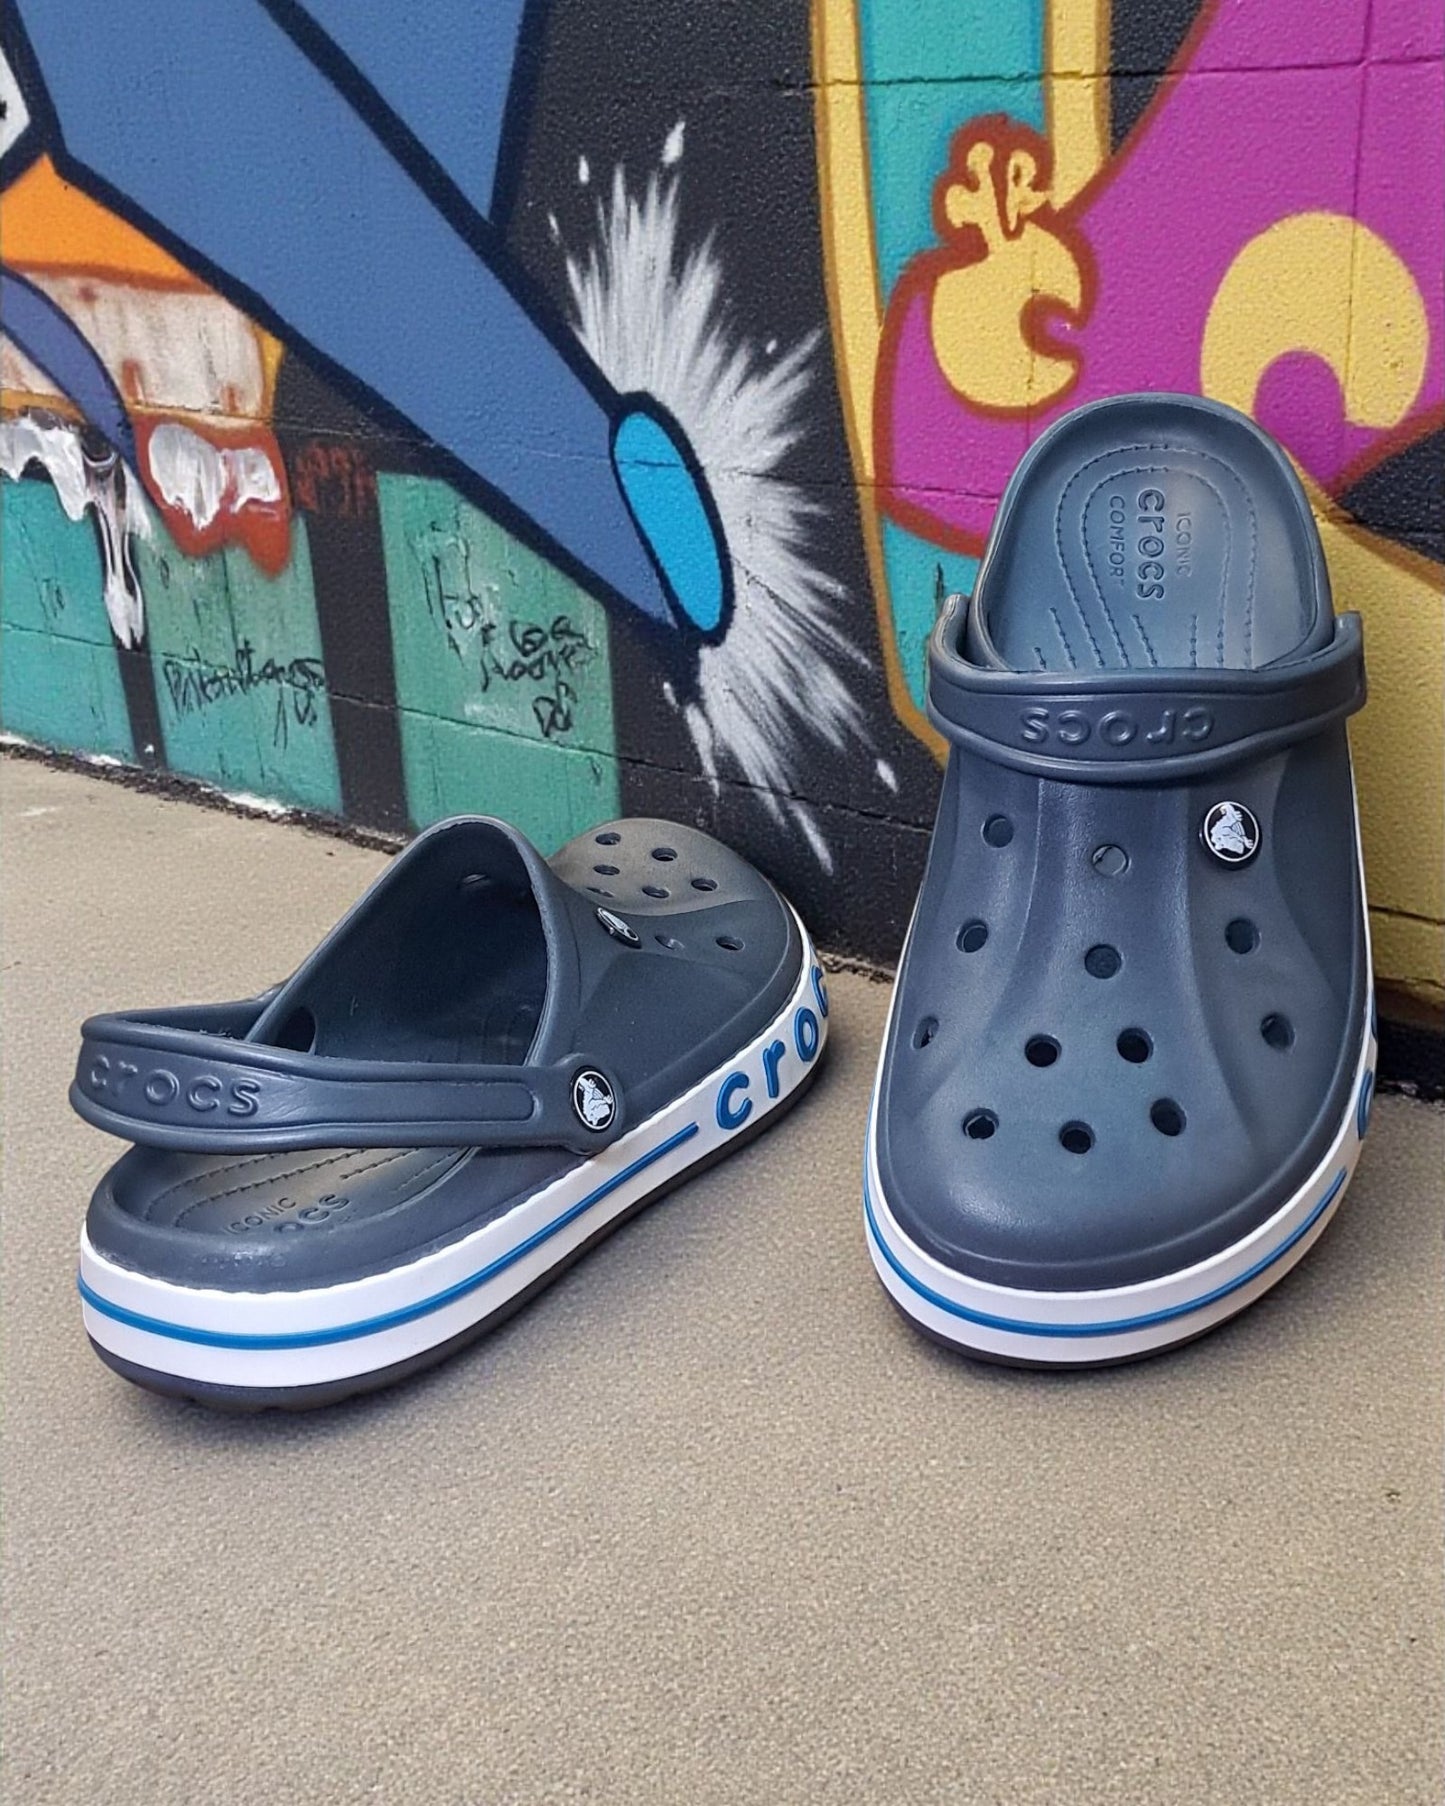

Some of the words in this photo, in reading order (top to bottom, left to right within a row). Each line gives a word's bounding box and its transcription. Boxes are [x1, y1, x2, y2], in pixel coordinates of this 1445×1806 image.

[1137, 489, 1166, 600] crocs
[1175, 511, 1192, 577] ICONIC
[1020, 706, 1214, 746] crocs
